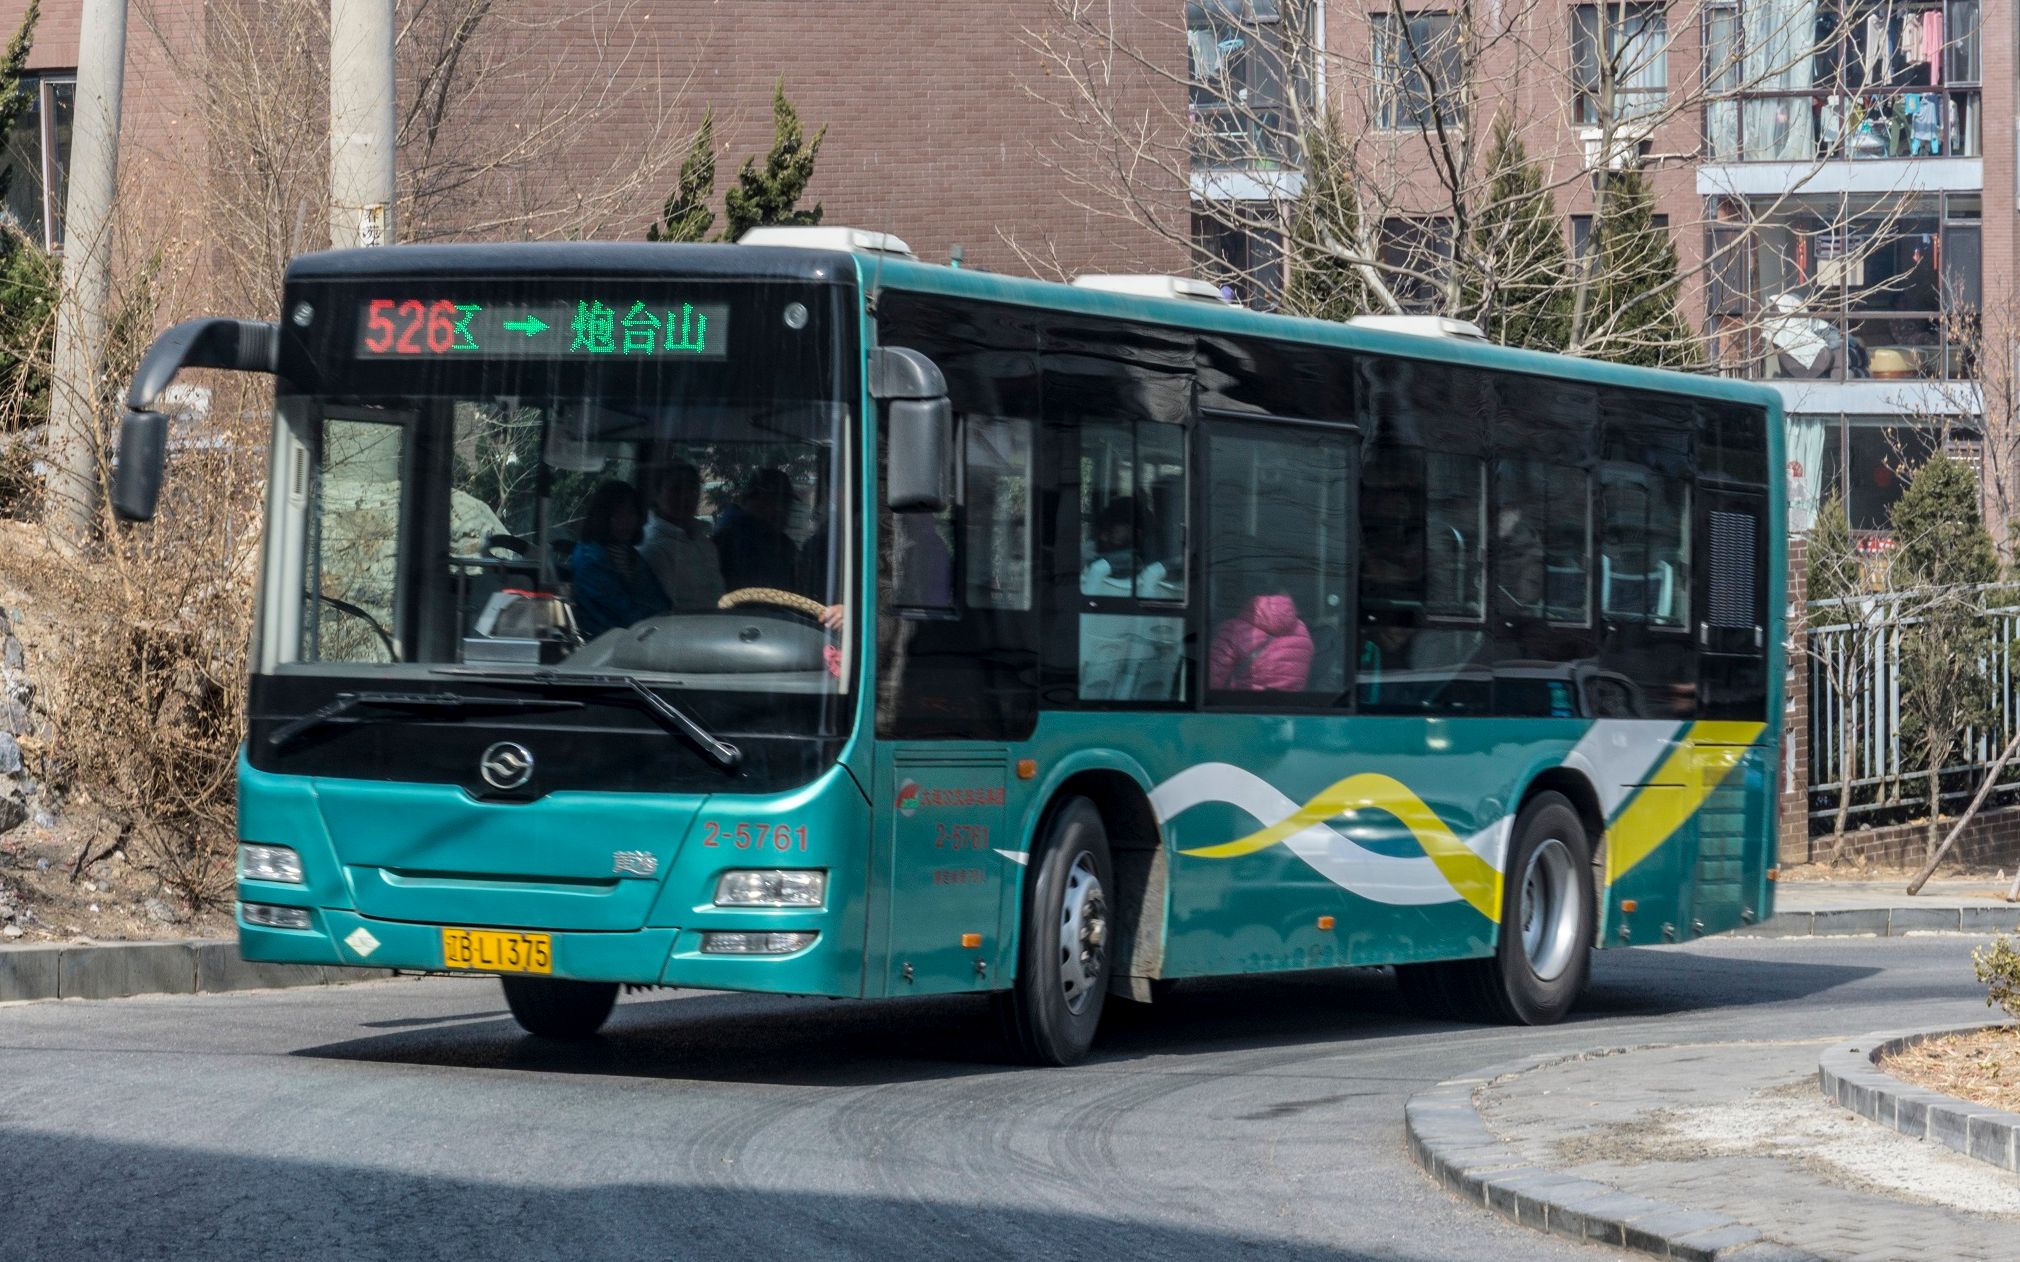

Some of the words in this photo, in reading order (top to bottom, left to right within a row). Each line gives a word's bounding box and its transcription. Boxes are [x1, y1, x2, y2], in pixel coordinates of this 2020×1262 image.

[365, 299, 457, 353] 526
[570, 300, 707, 355] 炮台山
[703, 821, 807, 851] 2-5761
